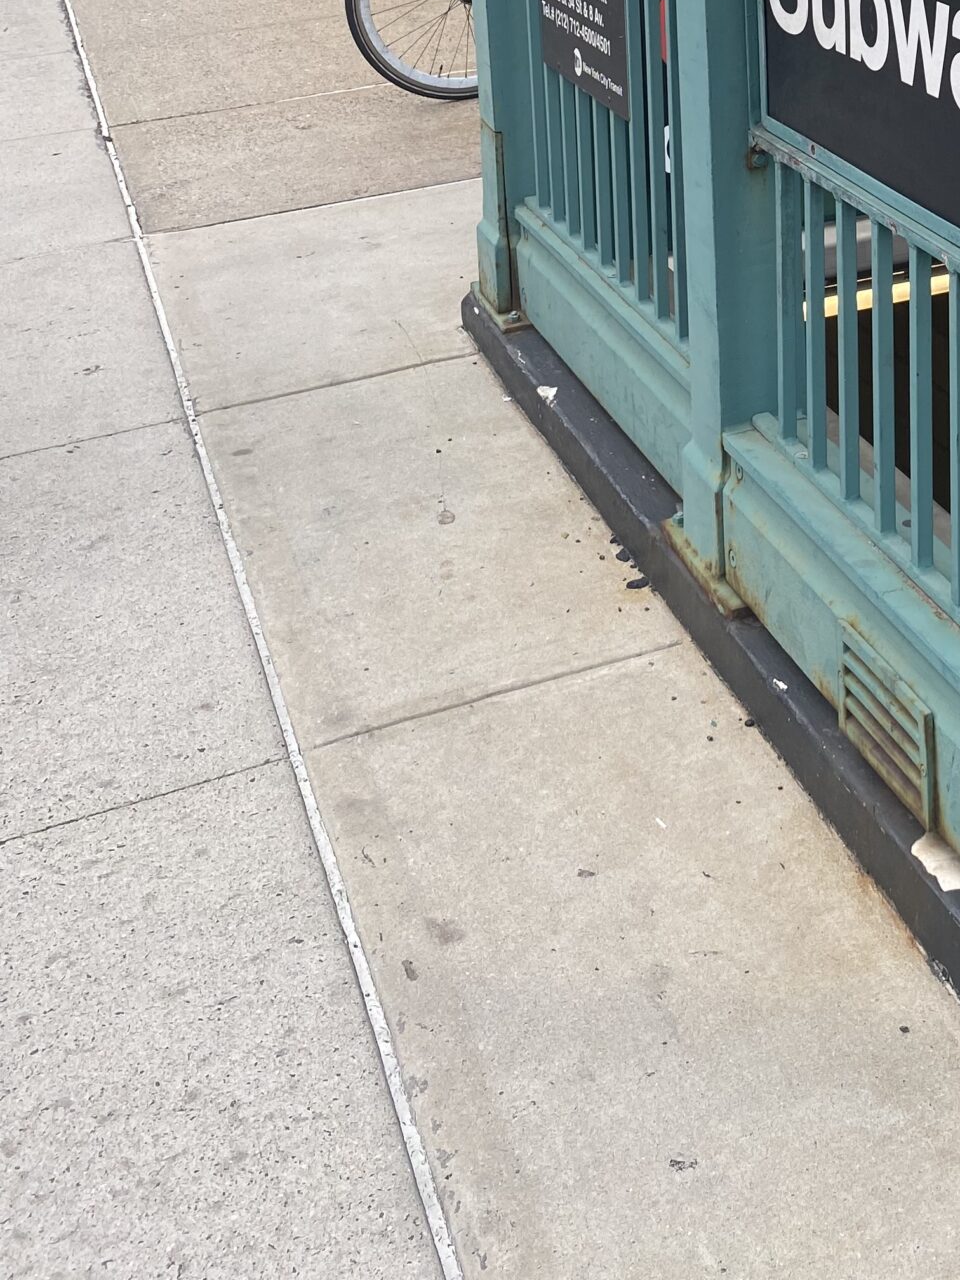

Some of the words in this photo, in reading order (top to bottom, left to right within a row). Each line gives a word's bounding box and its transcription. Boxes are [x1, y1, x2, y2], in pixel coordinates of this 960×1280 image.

[555, 8, 570, 35] (212)
[582, 1, 589, 19] &
[588, 4, 594, 22] 8
[594, 7, 605, 28] Av.
